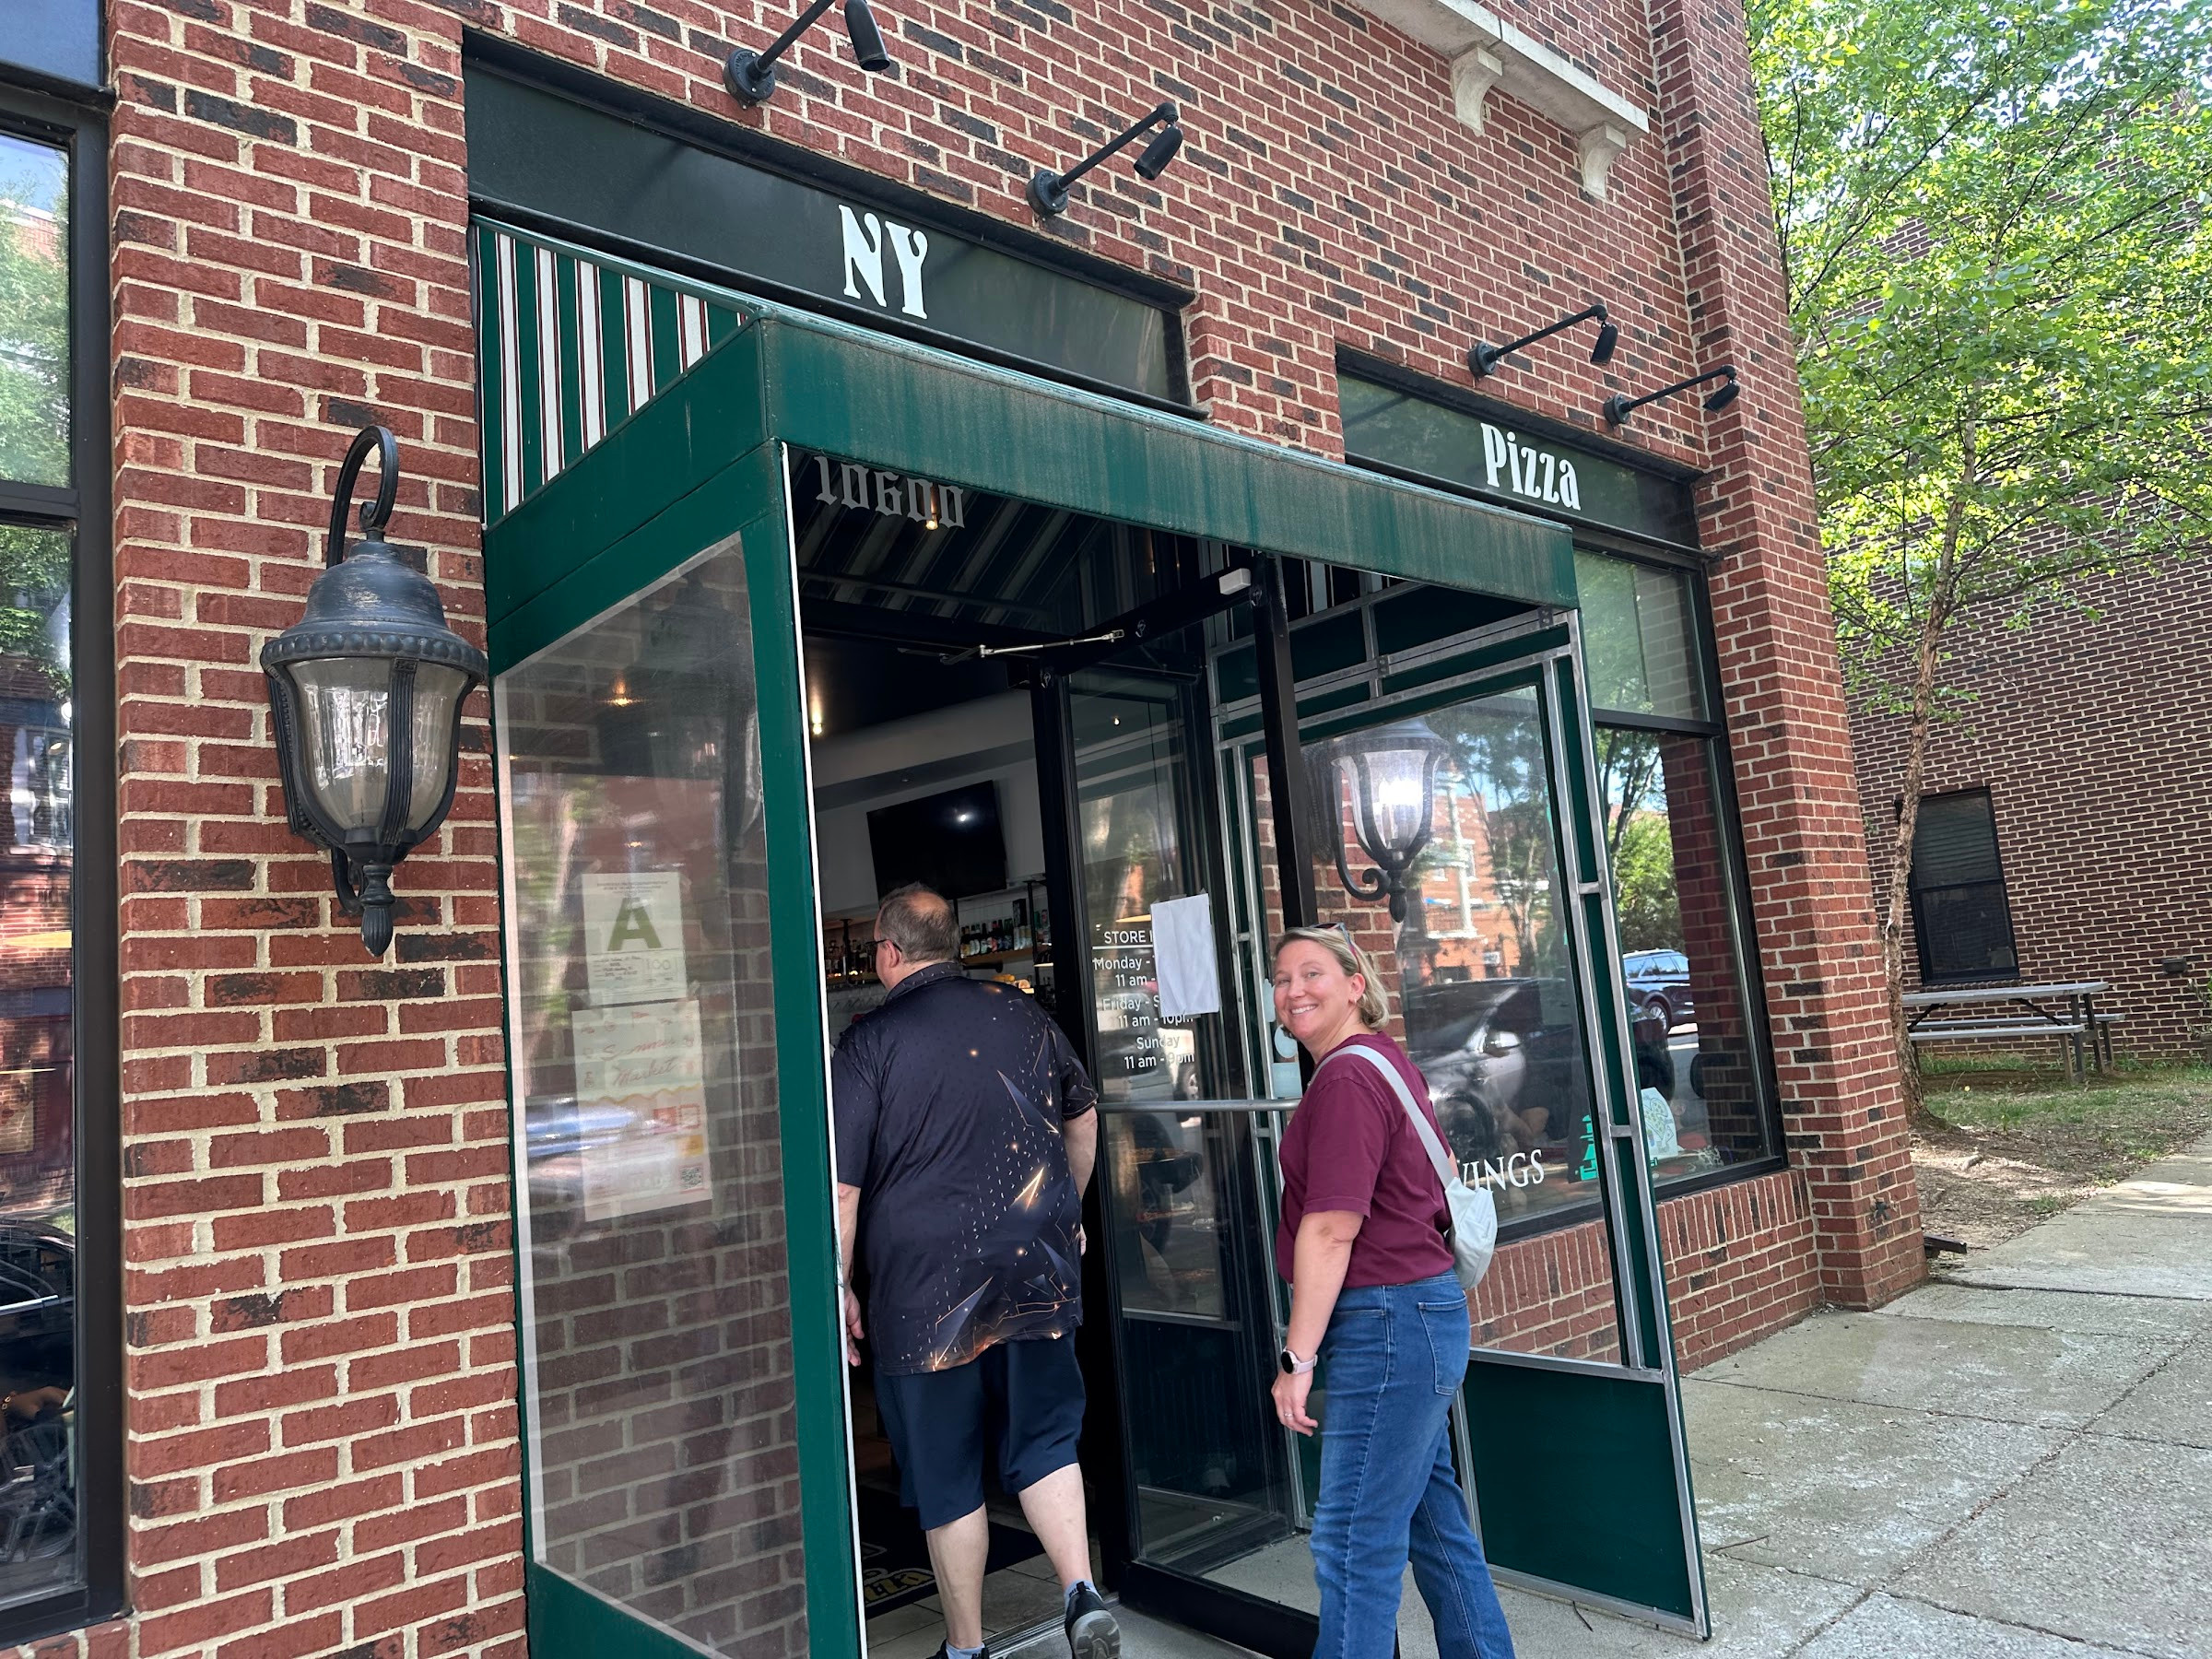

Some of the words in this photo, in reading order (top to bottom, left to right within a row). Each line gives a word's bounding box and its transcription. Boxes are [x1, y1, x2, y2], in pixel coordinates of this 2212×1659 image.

[838, 204, 929, 320] NY
[1480, 422, 1582, 511] Pizza
[814, 455, 966, 529] 10600
[607, 897, 662, 951] A
[1103, 930, 1146, 945] STORE
[1092, 956, 1142, 971] Monday
[1115, 973, 1125, 987] 11
[1129, 975, 1147, 986] am
[1102, 996, 1141, 1011] Friday
[1119, 1015, 1128, 1029] 11
[1132, 1016, 1150, 1027] am
[1136, 1034, 1180, 1050] Sunday
[1124, 1055, 1135, 1069] 11
[1138, 1056, 1157, 1068] am
